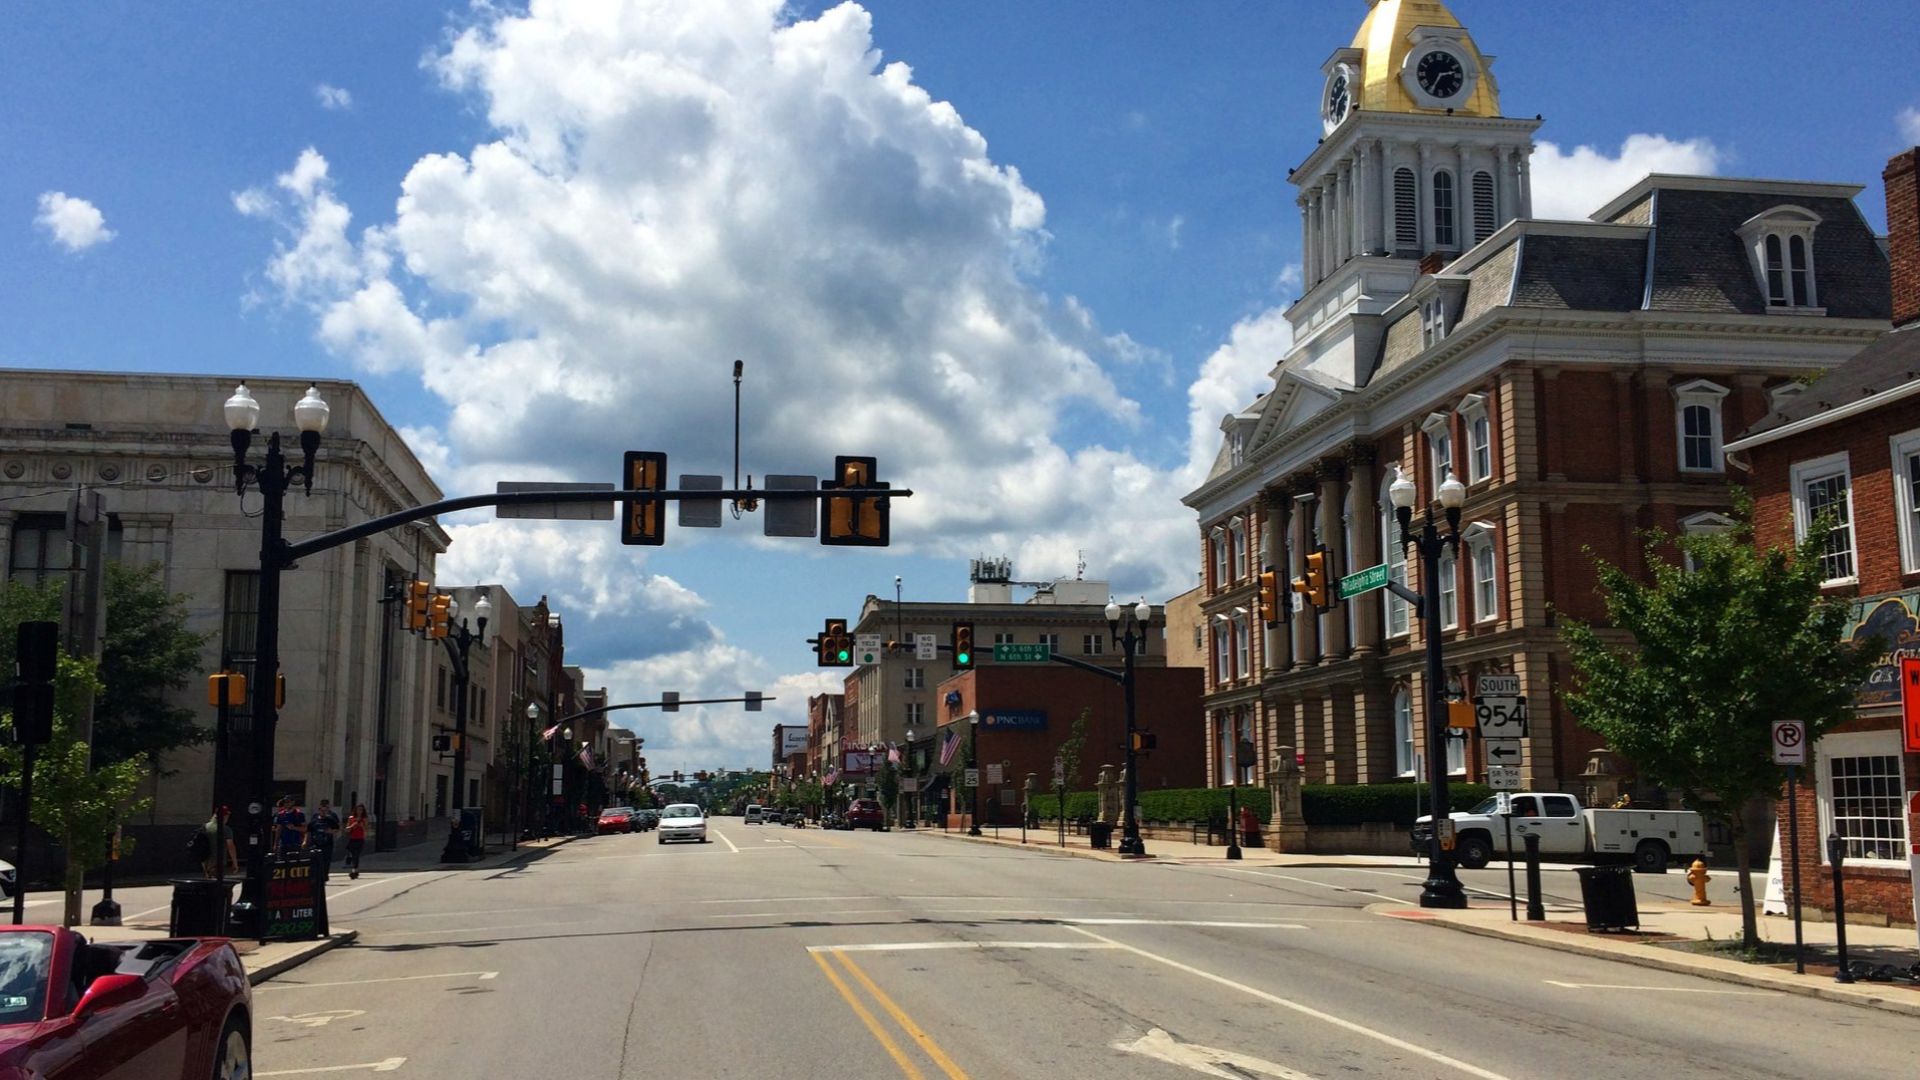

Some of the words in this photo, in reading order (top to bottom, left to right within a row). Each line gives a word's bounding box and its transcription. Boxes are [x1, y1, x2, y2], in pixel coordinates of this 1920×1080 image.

[1369, 567, 1385, 584] Street
[1481, 678, 1517, 692] SOUTH
[1478, 704, 1524, 727] 954
[966, 777, 978, 785] 25
[292, 908, 313, 919] LITER
